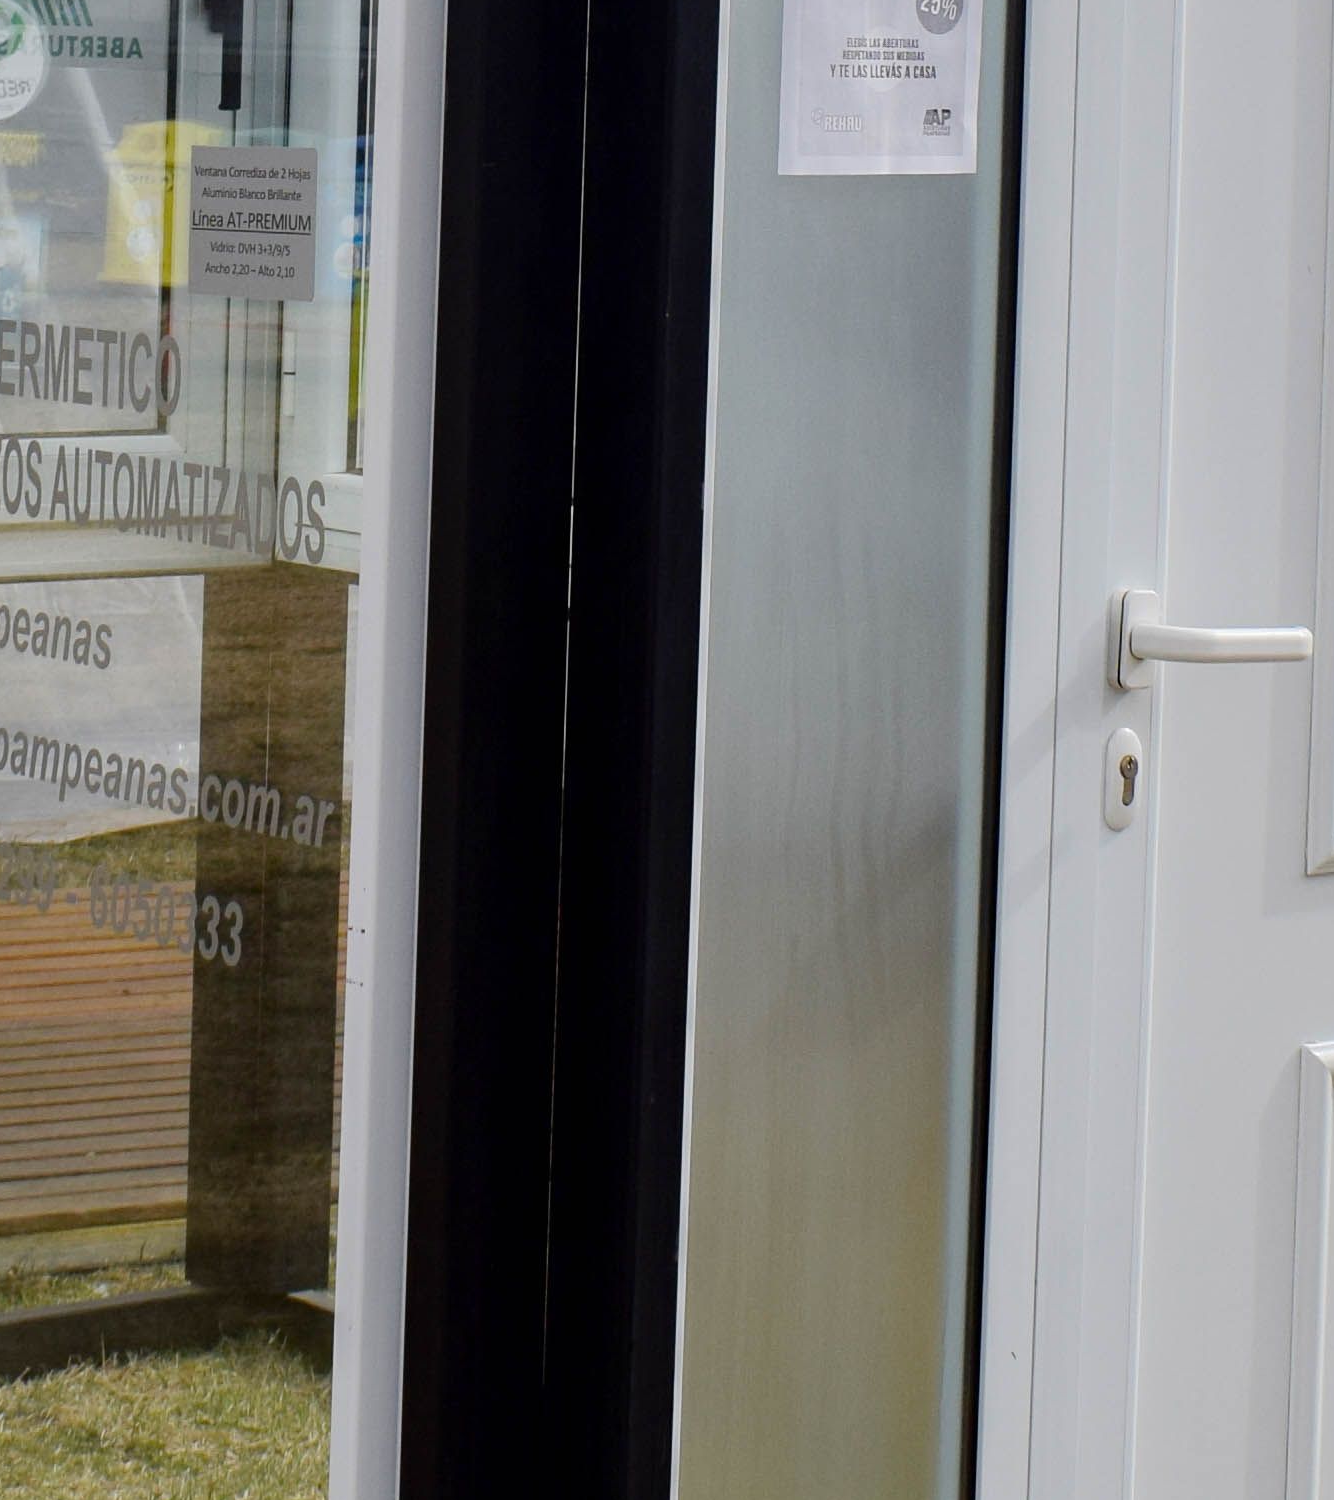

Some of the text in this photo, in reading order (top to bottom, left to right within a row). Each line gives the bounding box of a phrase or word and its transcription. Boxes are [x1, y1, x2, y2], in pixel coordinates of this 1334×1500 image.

[830, 62, 937, 79] Y TE LAS LLEVÁS A CASA
[825, 114, 862, 132] REHAU
[194, 165, 311, 182] Ventana Corrediza de 2 Hojas
[202, 187, 302, 201] Aluminio Blanco Brillante
[192, 209, 312, 232] Línea AT-PREMIUM
[238, 243, 256, 255] DVH
[205, 262, 230, 275] Ancho
[258, 265, 274, 277] Alto
[277, 266, 295, 279] 2,10
[50, 445, 326, 565] AUTOMATIZADOS
